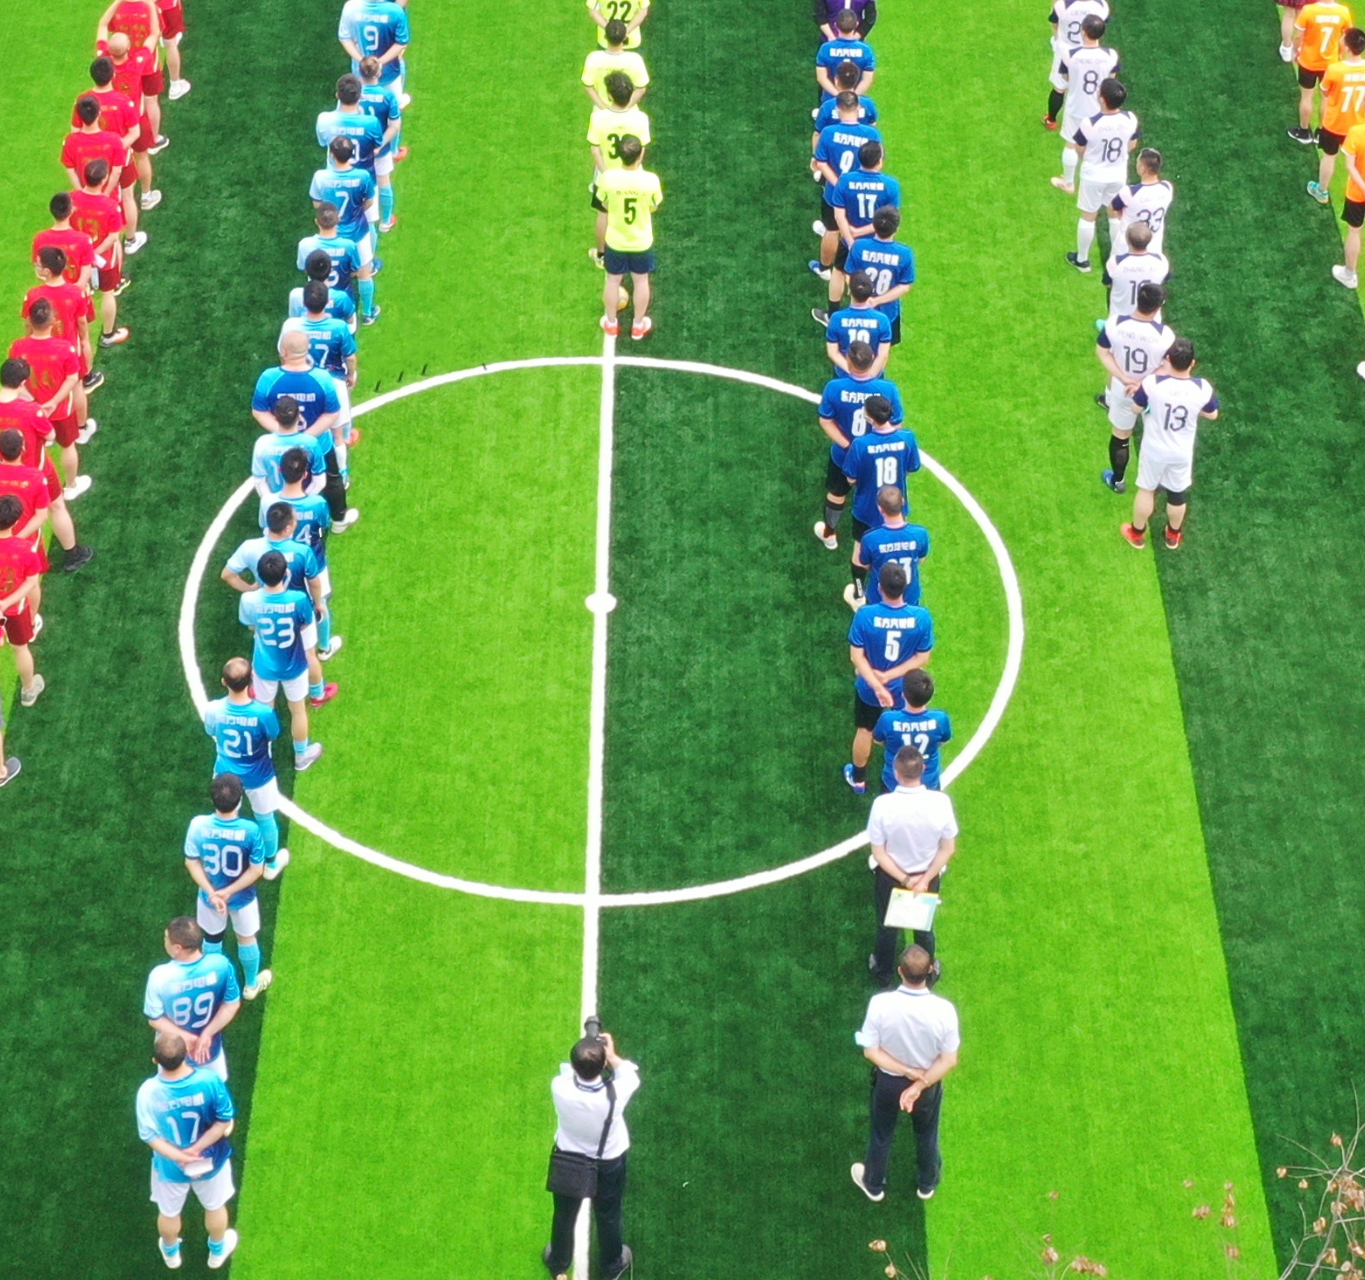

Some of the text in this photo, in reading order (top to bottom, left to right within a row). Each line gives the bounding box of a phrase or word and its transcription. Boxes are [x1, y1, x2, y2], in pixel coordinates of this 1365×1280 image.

[607, 1, 632, 24] 22
[364, 25, 379, 51] 9
[1320, 26, 1334, 54] 7
[1083, 70, 1098, 95] 8
[1101, 137, 1123, 163] 18
[335, 191, 350, 219] 7
[624, 198, 637, 225] 5
[856, 192, 877, 218] 17
[1137, 207, 1165, 233] 33
[1123, 346, 1148, 374] 19
[1164, 403, 1189, 432] 13
[875, 456, 898, 488] 18
[256, 617, 295, 649] 23
[884, 630, 902, 662] 5
[222, 728, 253, 758] 21
[202, 842, 243, 878] 30
[173, 990, 215, 1029] 89
[165, 1111, 201, 1147] 17
